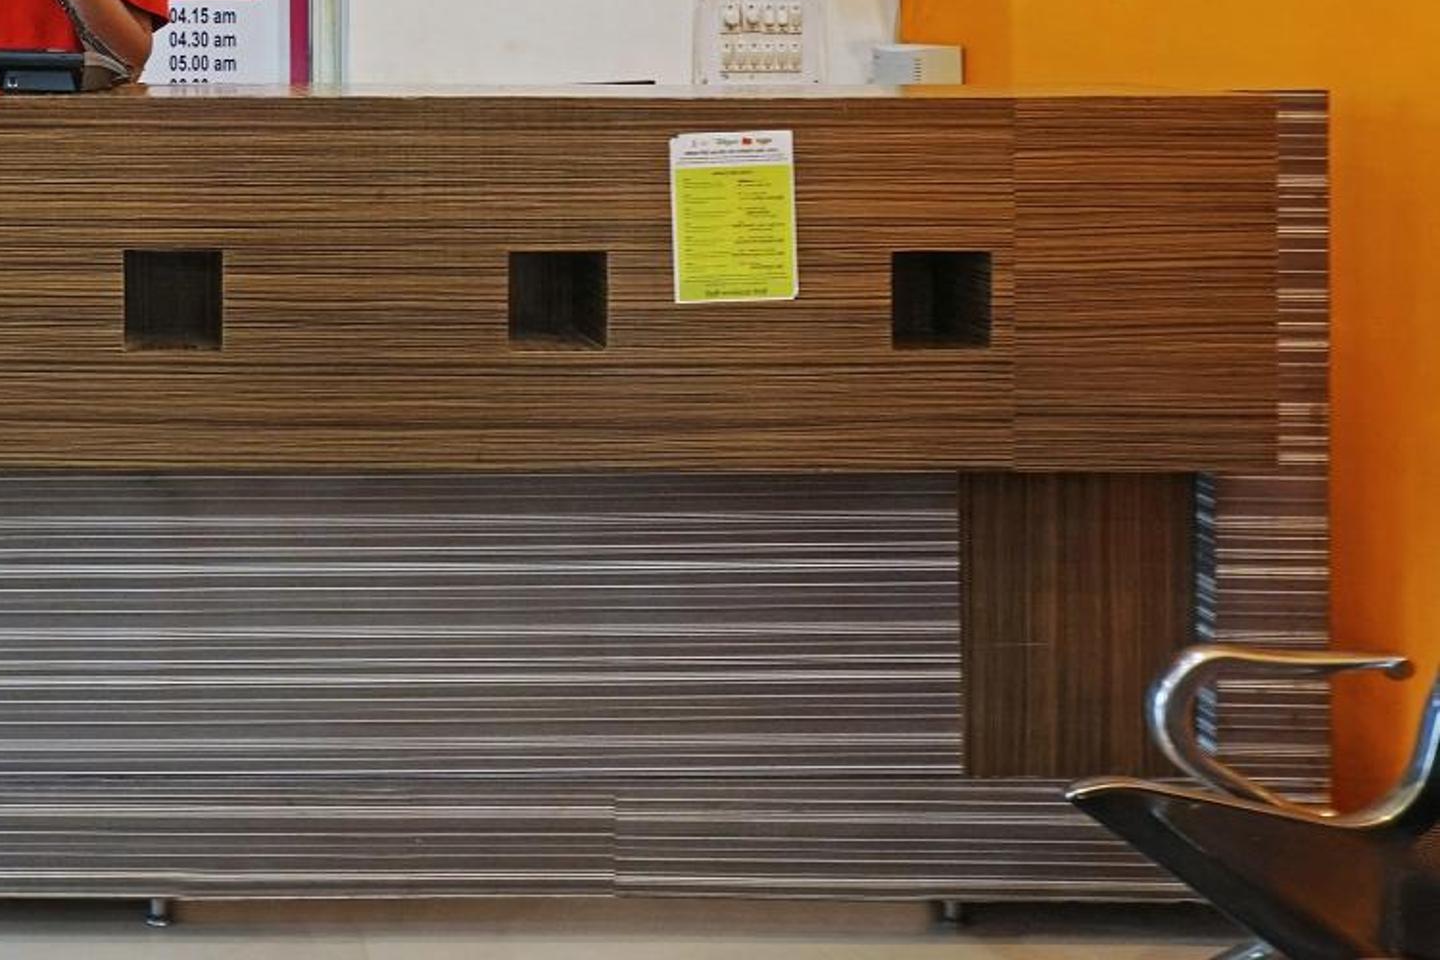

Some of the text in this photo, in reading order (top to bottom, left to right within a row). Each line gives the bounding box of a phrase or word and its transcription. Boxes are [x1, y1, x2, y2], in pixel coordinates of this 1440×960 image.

[169, 7, 237, 24] 04.15 am
[168, 31, 237, 47] 04.30 am
[168, 55, 237, 72] 05.00 am
